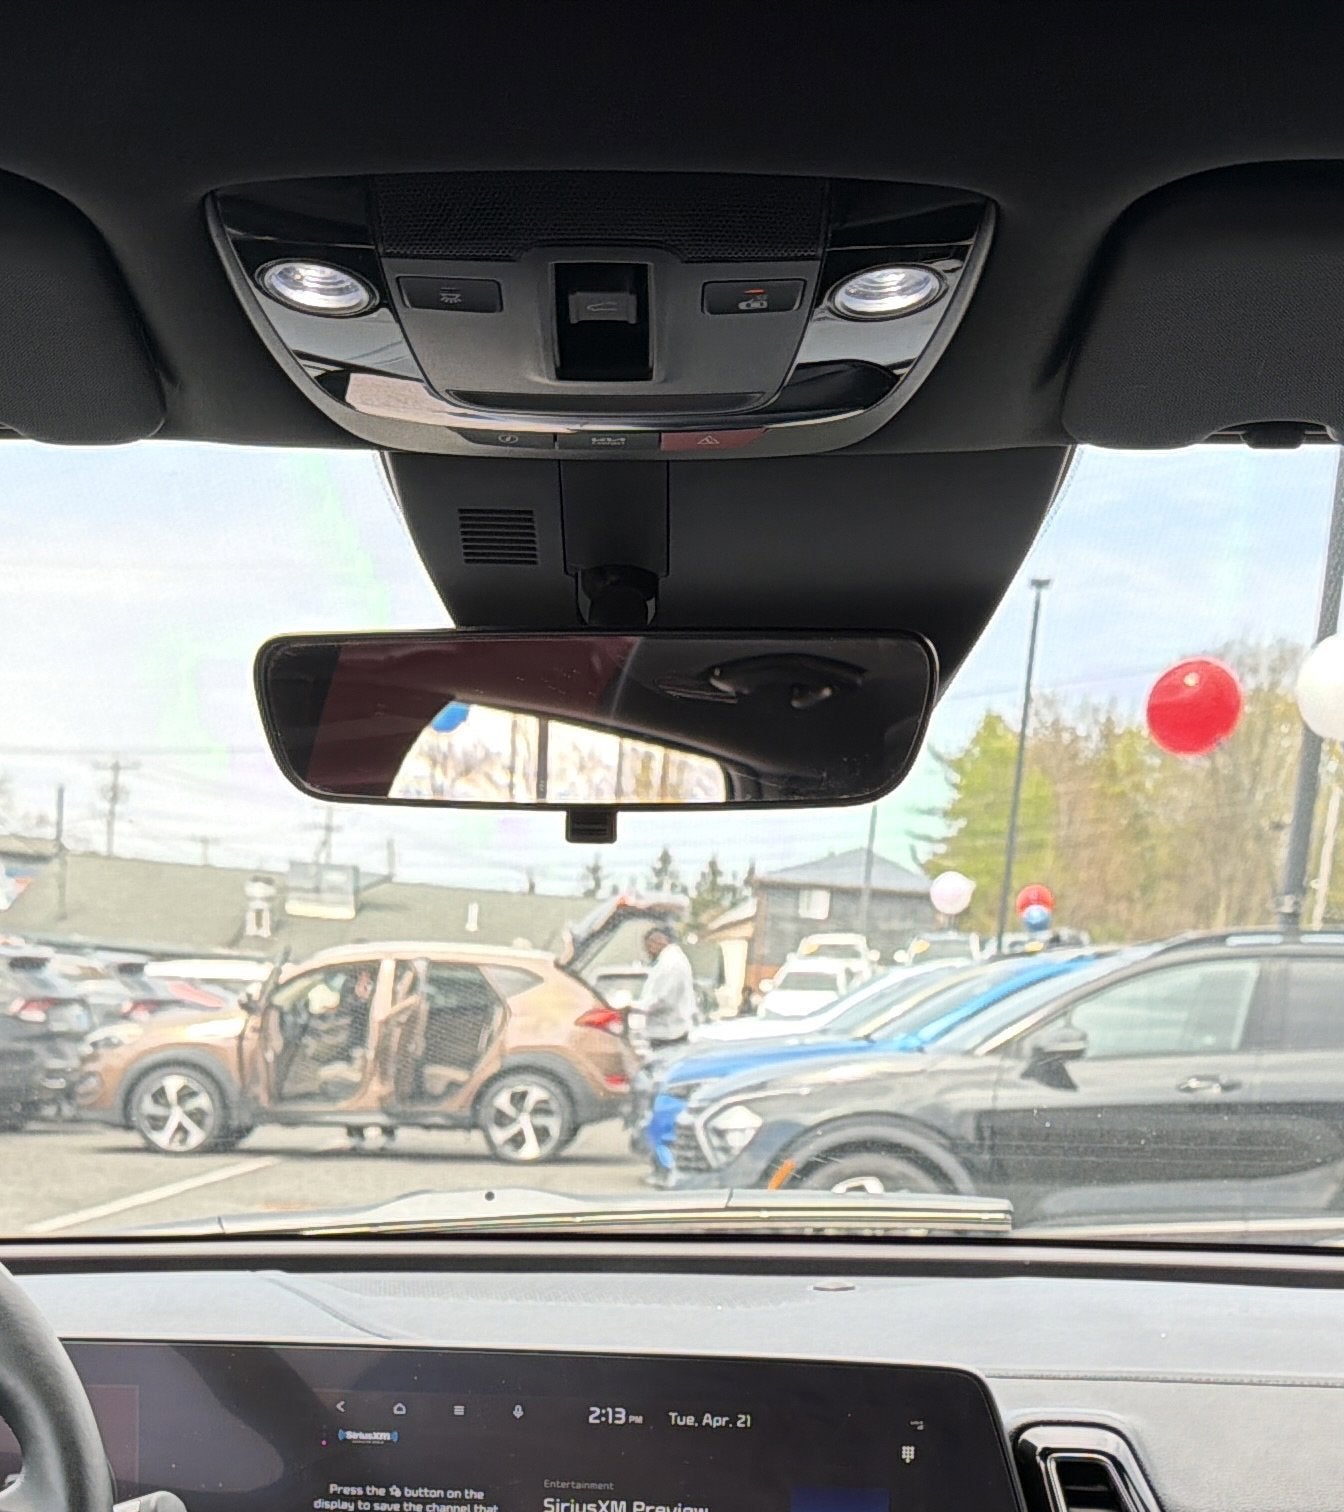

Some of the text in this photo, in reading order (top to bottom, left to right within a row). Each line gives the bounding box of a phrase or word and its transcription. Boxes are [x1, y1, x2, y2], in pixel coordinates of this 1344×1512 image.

[588, 1406, 751, 1429] 2:13 PM Tue, Apr. 21
[345, 1430, 391, 1441] SiriusXM
[329, 1483, 485, 1500] Press the button on the
[543, 1479, 615, 1491] Entertainment
[313, 1499, 355, 1512] display
[357, 1501, 371, 1511] to
[373, 1502, 400, 1512] save
[403, 1501, 423, 1512] the
